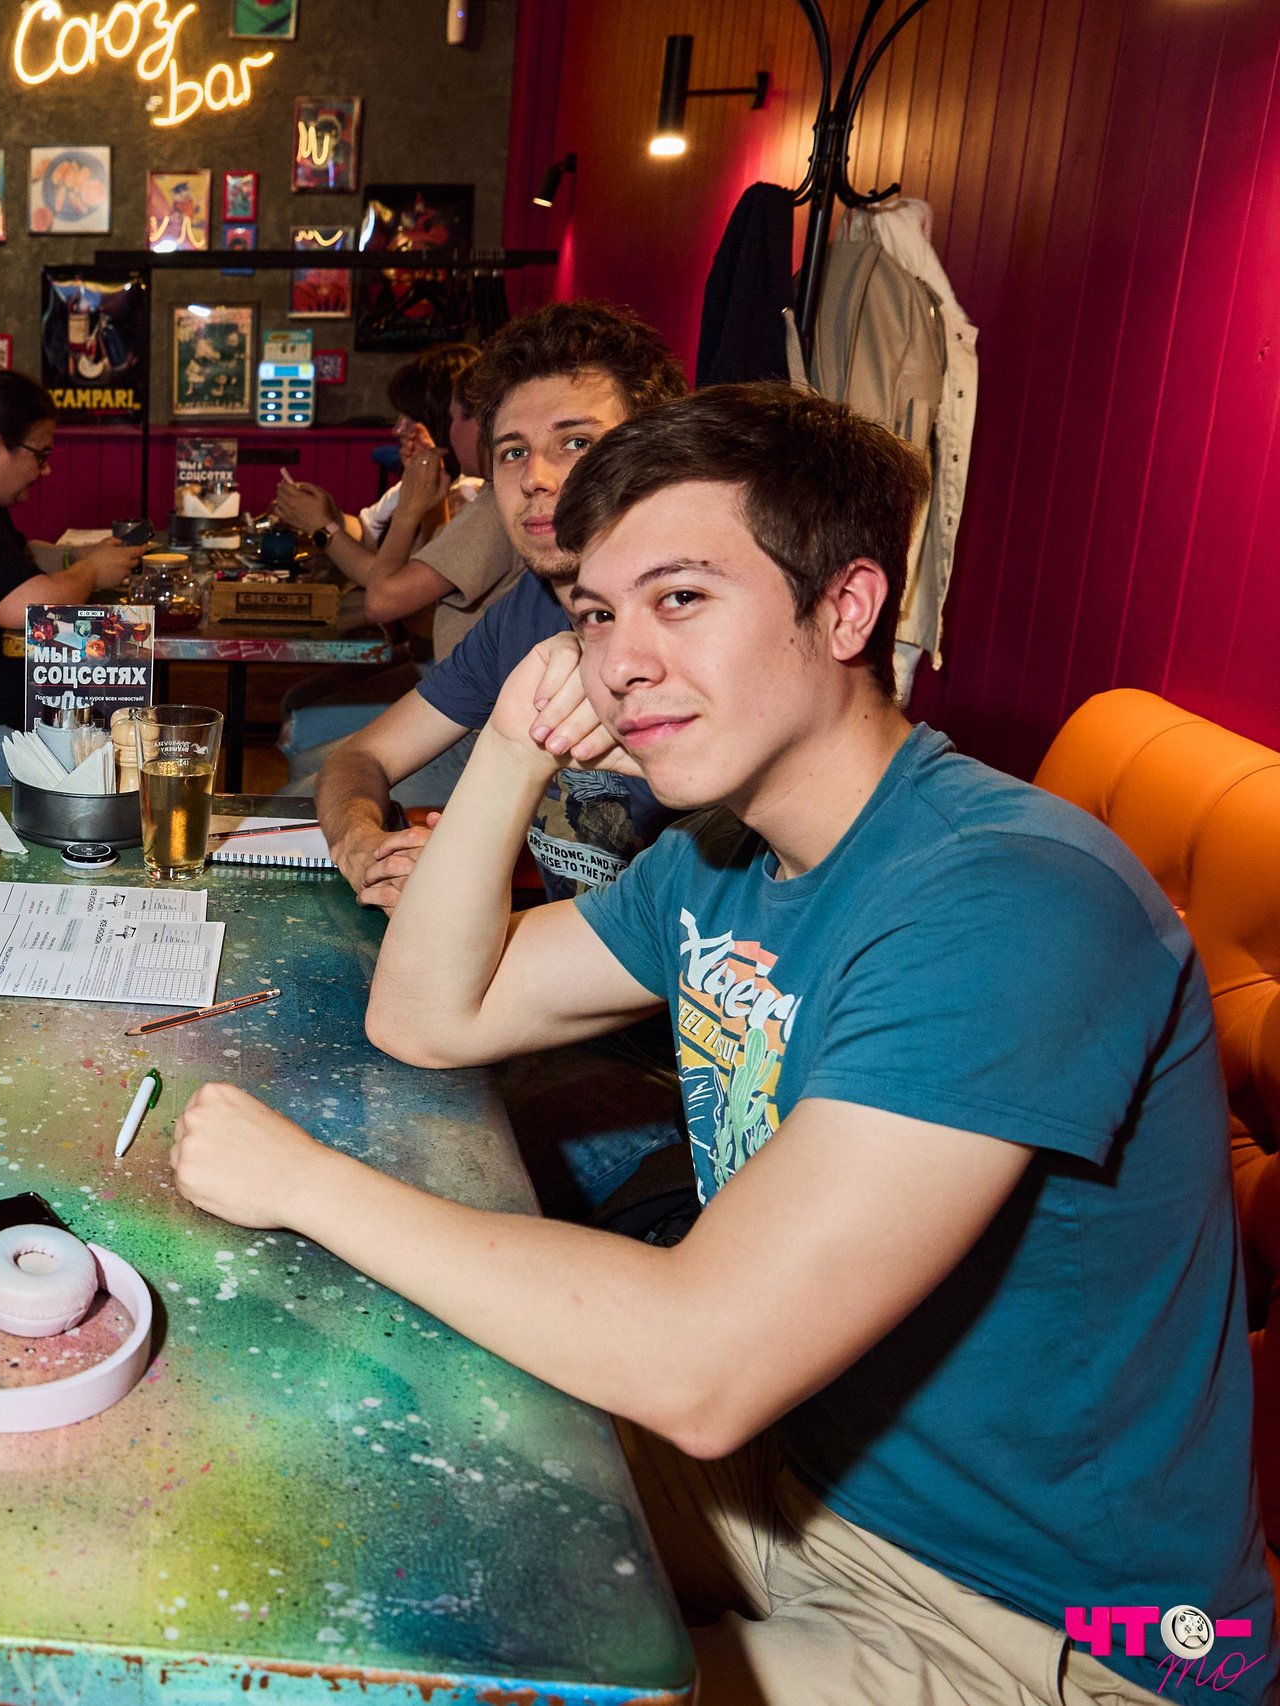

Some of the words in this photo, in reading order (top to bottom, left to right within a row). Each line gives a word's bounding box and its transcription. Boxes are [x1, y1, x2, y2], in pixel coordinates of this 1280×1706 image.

[14, 0, 195, 84] Союз
[152, 52, 274, 126] bar
[540, 853, 562, 868] RISE
[563, 861, 578, 872] TO
[579, 864, 601, 879] THE
[542, 843, 589, 862] STRONG.
[590, 854, 609, 870] AND
[610, 862, 627, 873] YO
